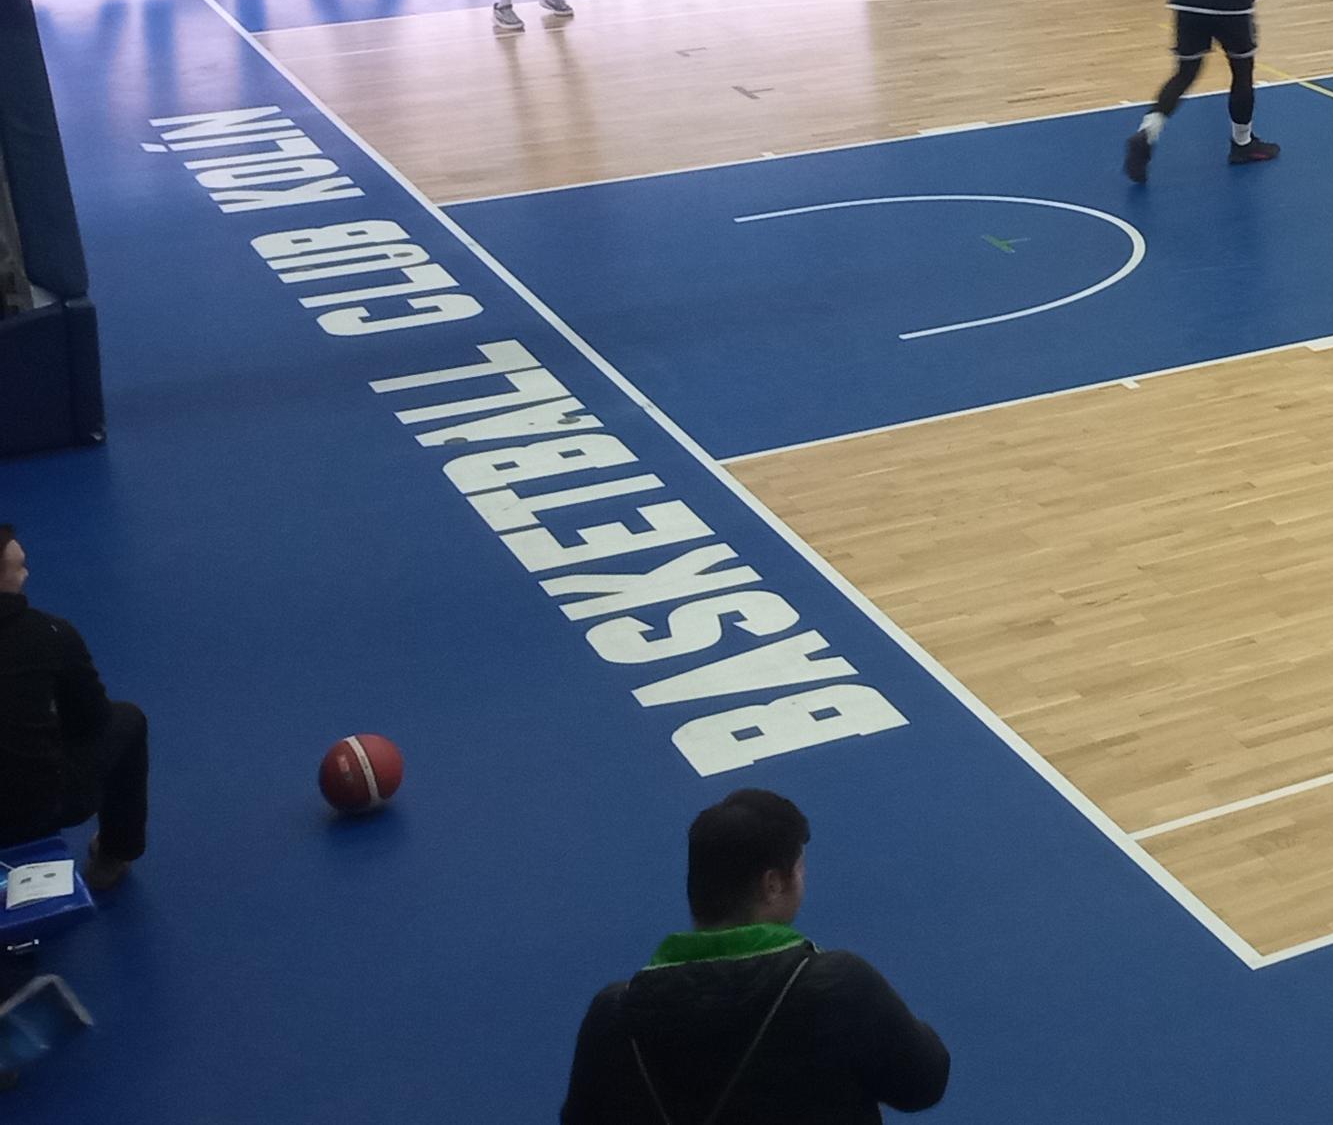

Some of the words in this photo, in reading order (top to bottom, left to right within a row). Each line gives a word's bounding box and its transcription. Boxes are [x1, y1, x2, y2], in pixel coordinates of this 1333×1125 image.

[141, 104, 366, 213] KOLÍN
[249, 218, 485, 337] CLUB
[367, 338, 910, 777] BASKETBALL
